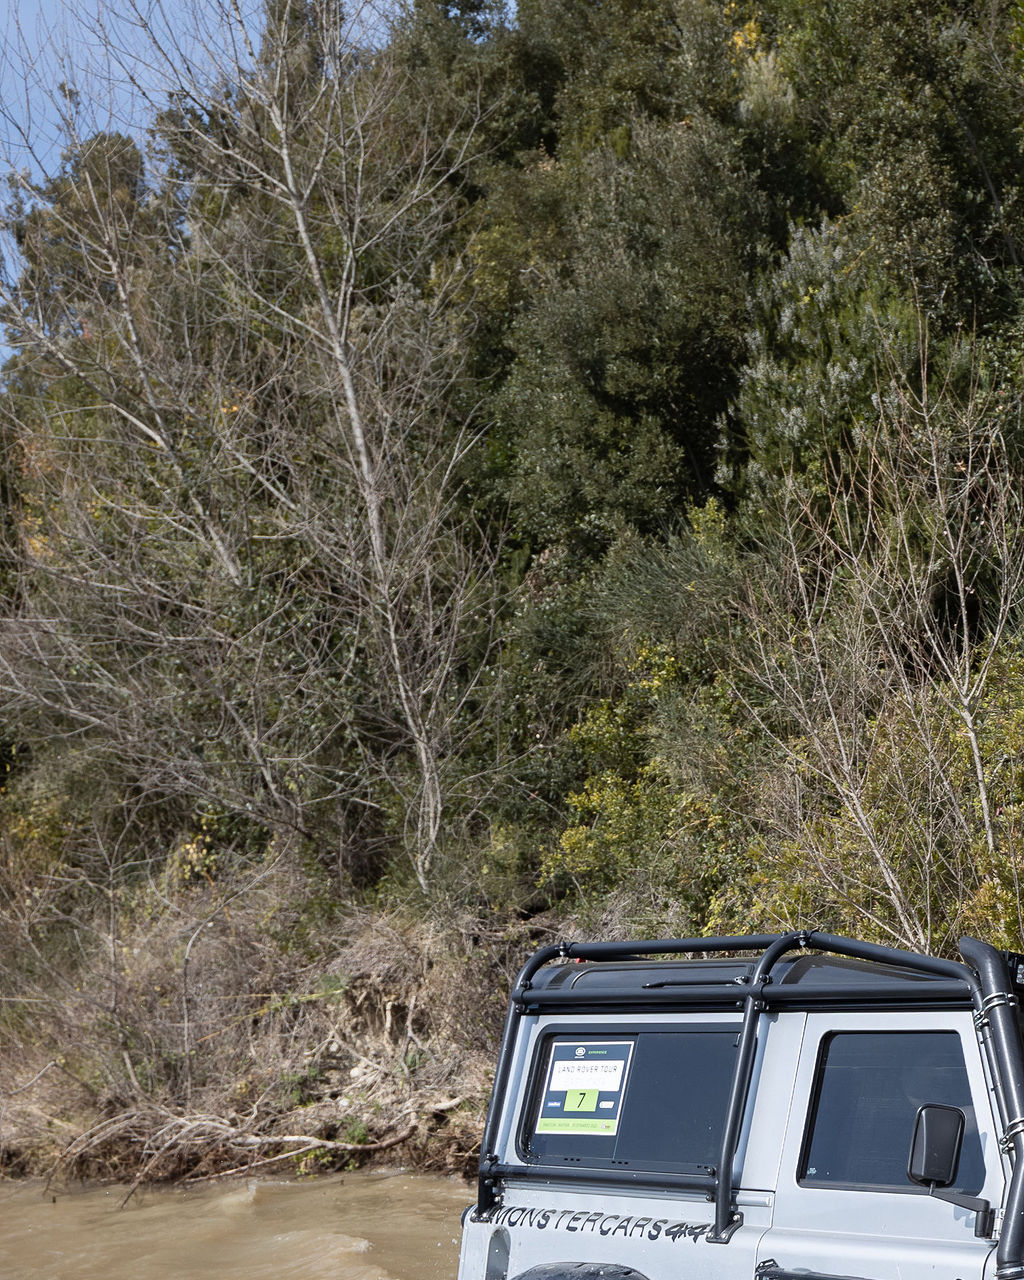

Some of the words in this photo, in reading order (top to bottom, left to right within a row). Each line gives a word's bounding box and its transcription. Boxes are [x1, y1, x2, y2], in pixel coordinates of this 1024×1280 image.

[558, 1065, 575, 1073] LAND
[577, 1065, 598, 1073] ROVER
[600, 1065, 618, 1073] TOUR
[577, 1092, 586, 1109] 7
